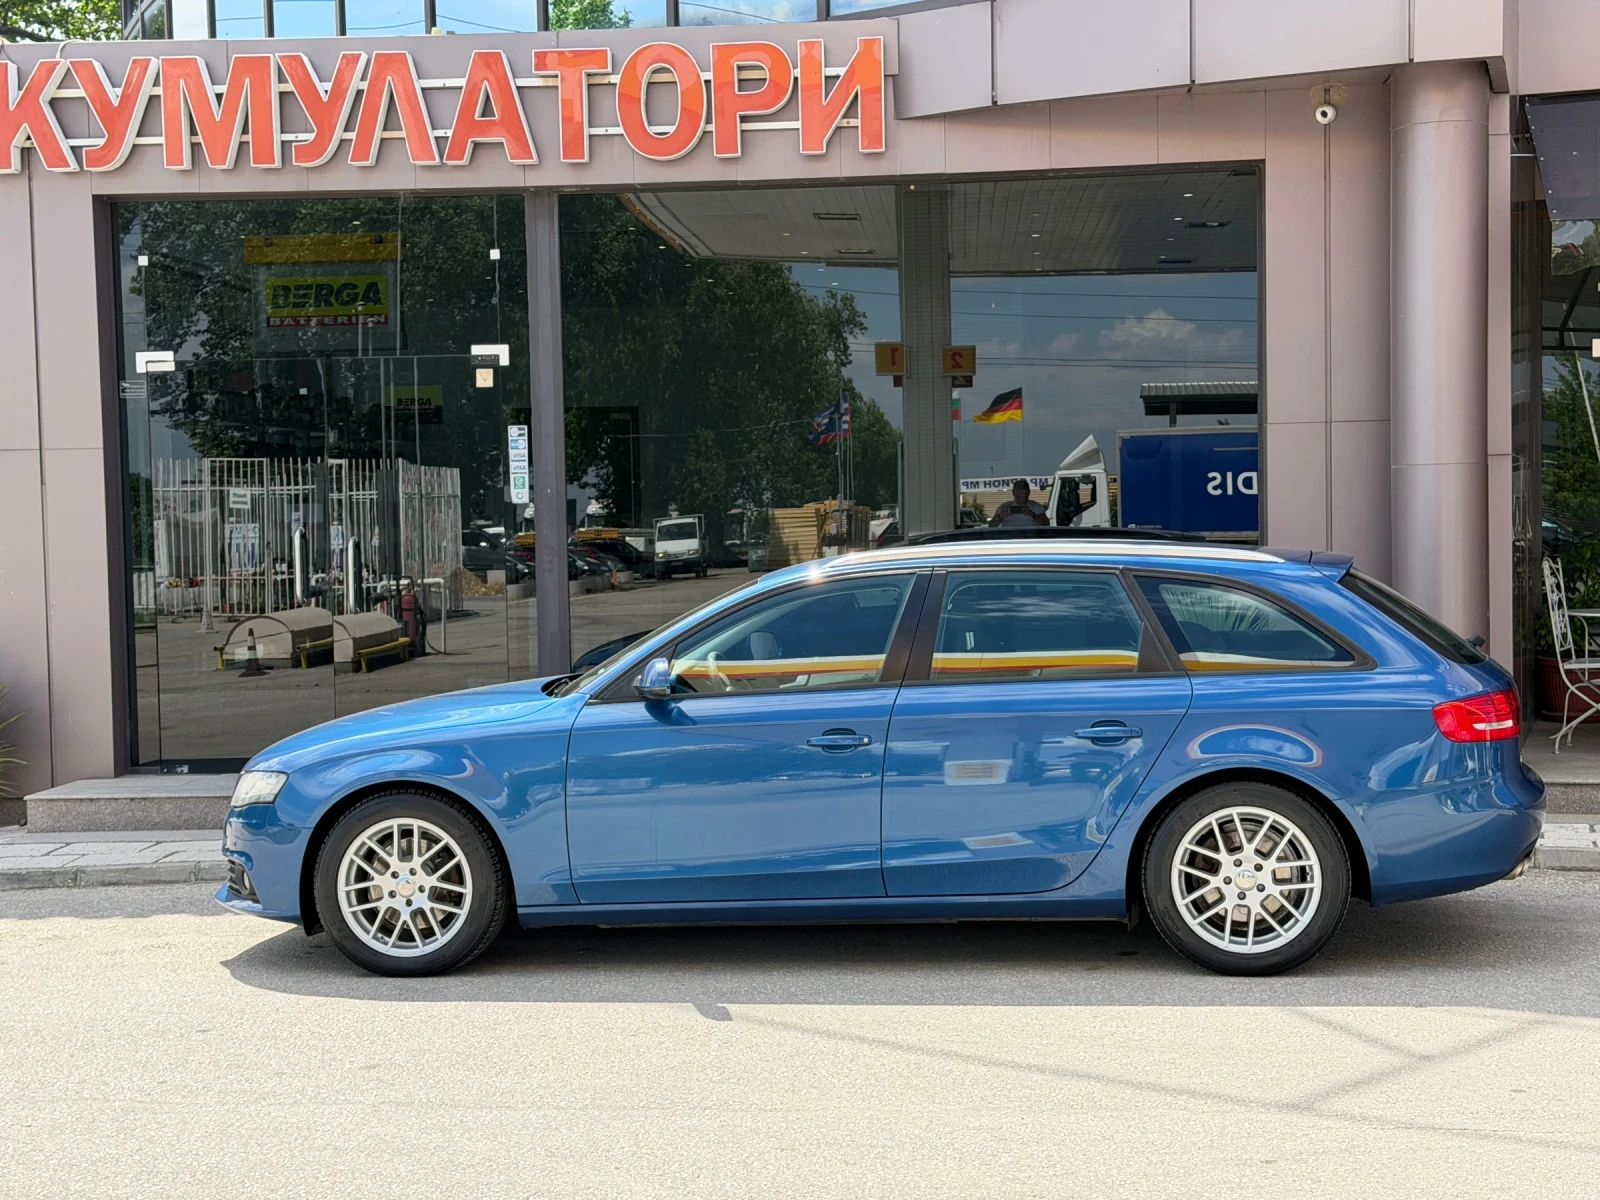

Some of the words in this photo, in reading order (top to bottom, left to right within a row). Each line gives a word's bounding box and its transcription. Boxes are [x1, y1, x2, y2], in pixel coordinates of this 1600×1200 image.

[271, 282, 384, 309] BERGA
[269, 314, 386, 327] BATTERIEN
[396, 397, 432, 406] BERGA
